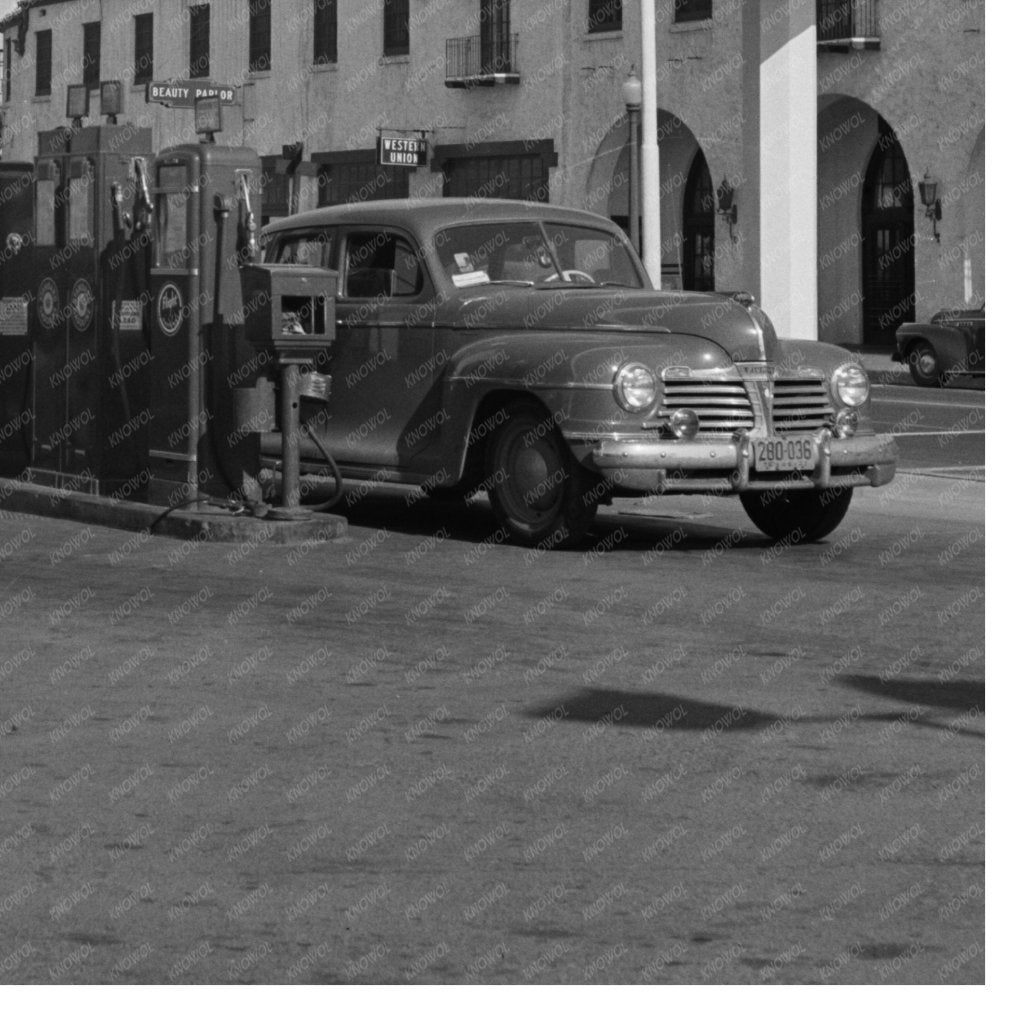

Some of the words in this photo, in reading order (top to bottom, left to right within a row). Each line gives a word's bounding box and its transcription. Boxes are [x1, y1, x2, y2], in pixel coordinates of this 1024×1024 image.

[152, 86, 190, 99] BEAUTY
[384, 139, 426, 153] WESTERN
[390, 151, 419, 164] UNION
[757, 440, 812, 461] 280-036
